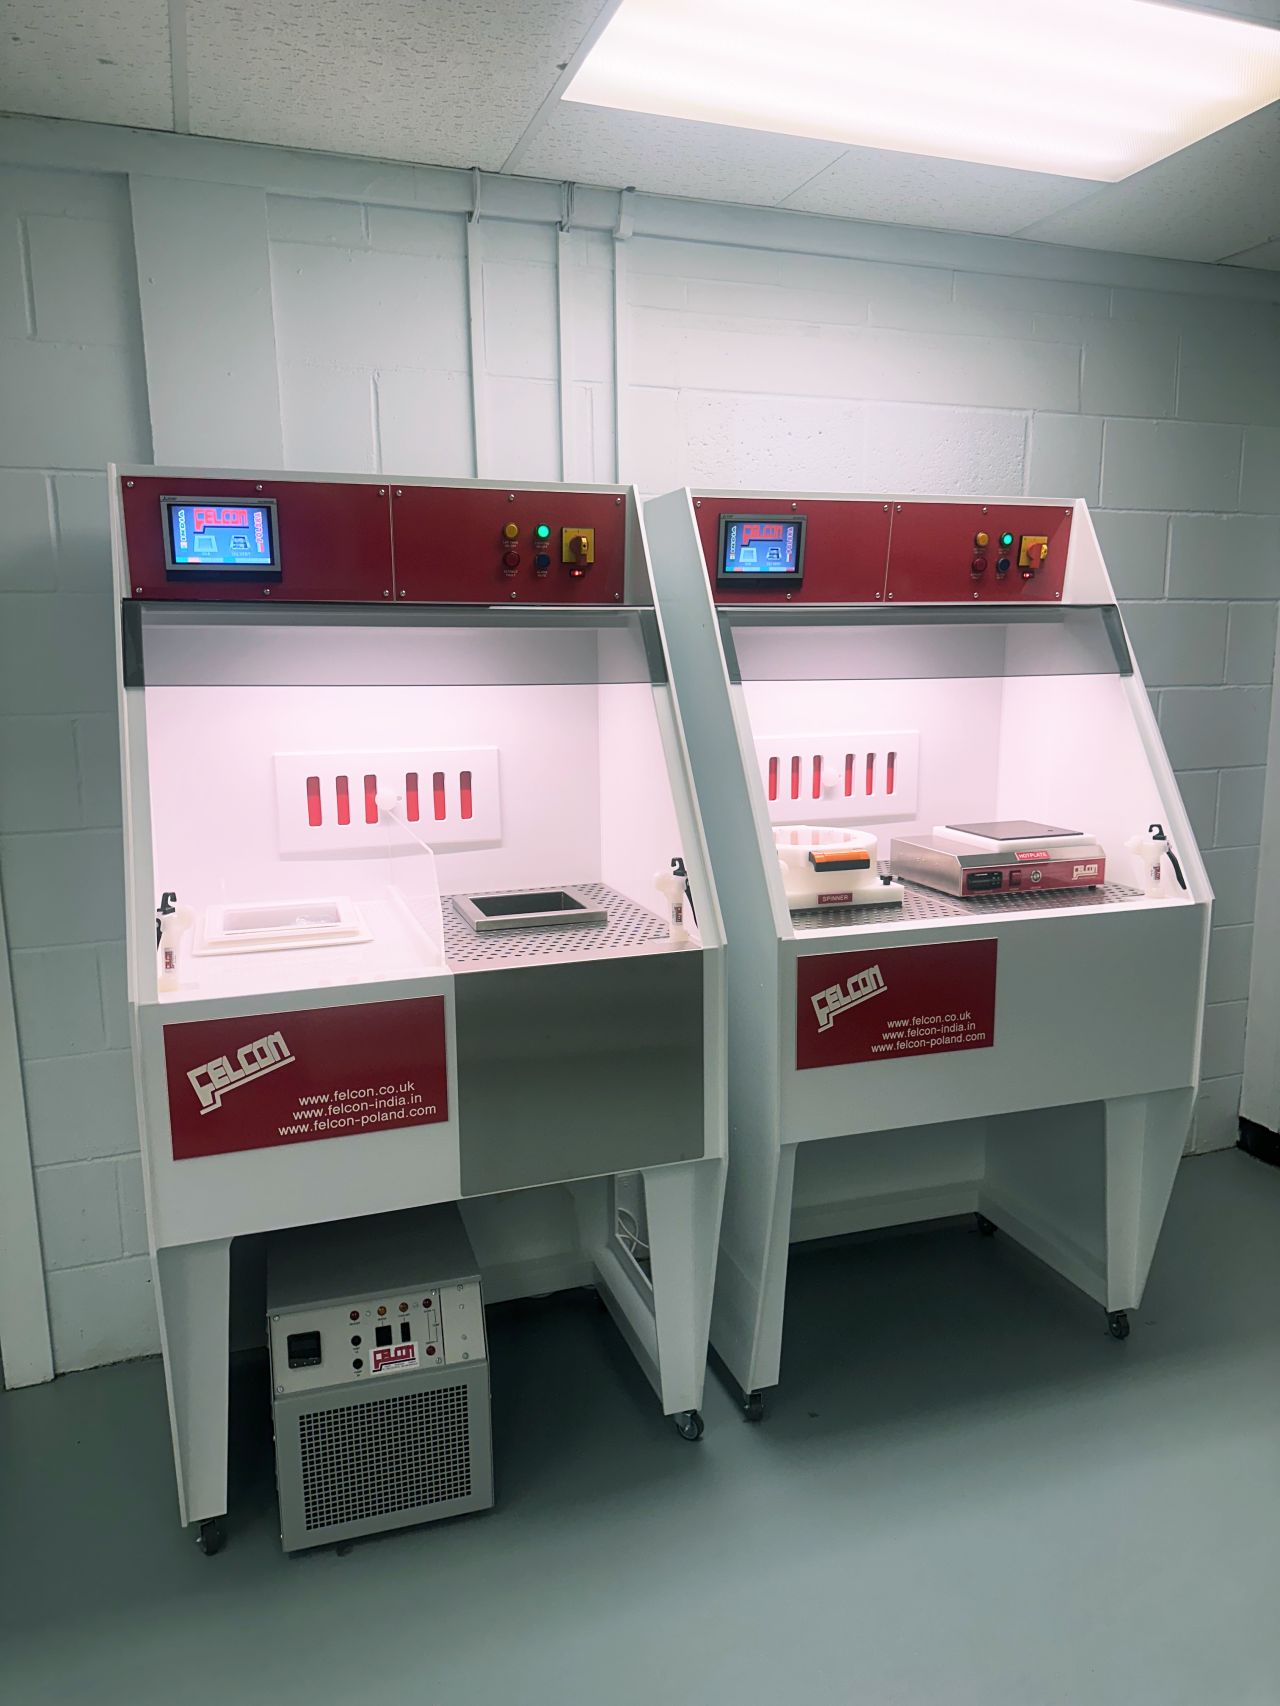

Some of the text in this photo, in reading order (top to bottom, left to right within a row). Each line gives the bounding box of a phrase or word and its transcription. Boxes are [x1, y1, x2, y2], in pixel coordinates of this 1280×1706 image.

[193, 508, 249, 532] FELCON
[1018, 851, 1048, 859] HOTPLATE
[822, 894, 849, 902] SPINNER
[810, 964, 885, 1026] FELCON
[882, 1021, 976, 1040] www.felcon-india.in
[887, 1010, 972, 1029] www.felcon.co.uk
[871, 1031, 986, 1053] www.felcon-poland.com
[187, 1031, 291, 1107] FELCON
[299, 1081, 415, 1106] www.felcon.co.uk
[292, 1093, 422, 1120] www.felcon-india.in
[278, 1104, 437, 1136] www.felcon-poland.com
[373, 1344, 415, 1370] FELCON
